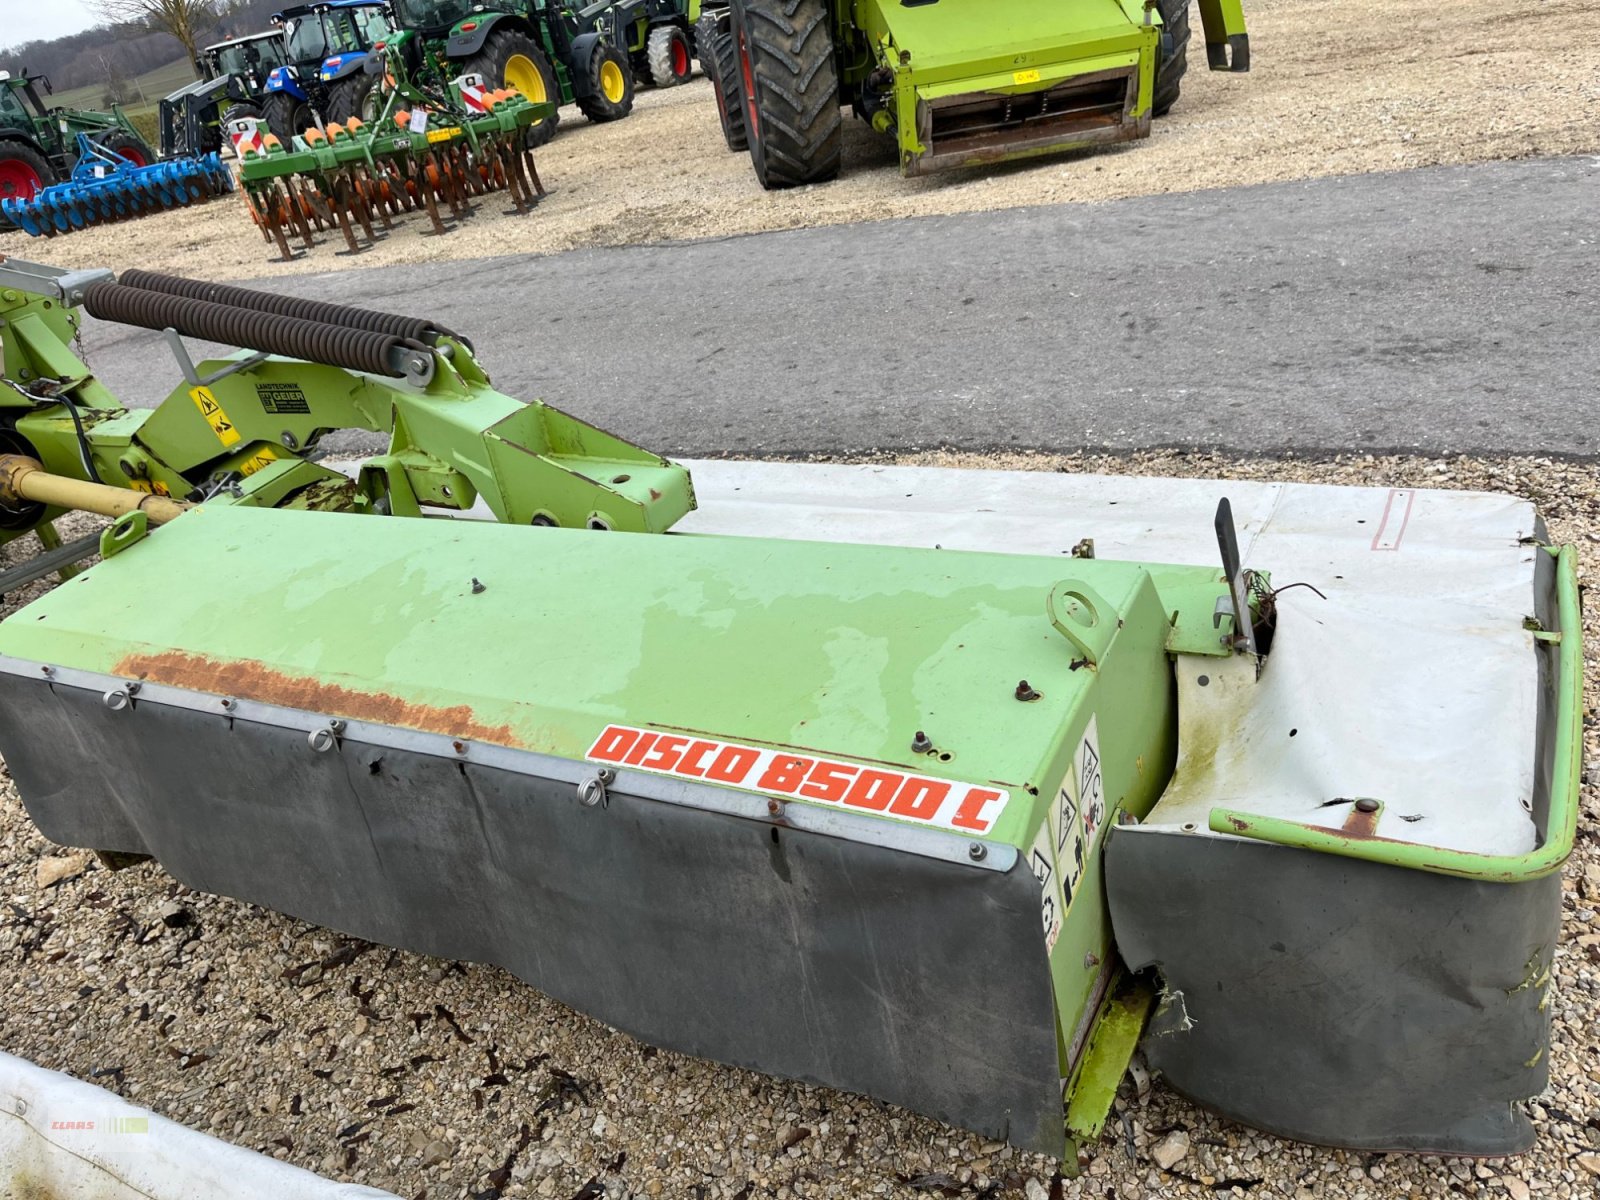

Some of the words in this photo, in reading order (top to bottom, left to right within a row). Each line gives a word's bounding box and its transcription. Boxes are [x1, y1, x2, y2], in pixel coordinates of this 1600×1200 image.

[272, 391, 304, 400] GEIER
[588, 726, 761, 784] DISCO
[757, 754, 951, 820] 8500
[951, 788, 1001, 831] C
